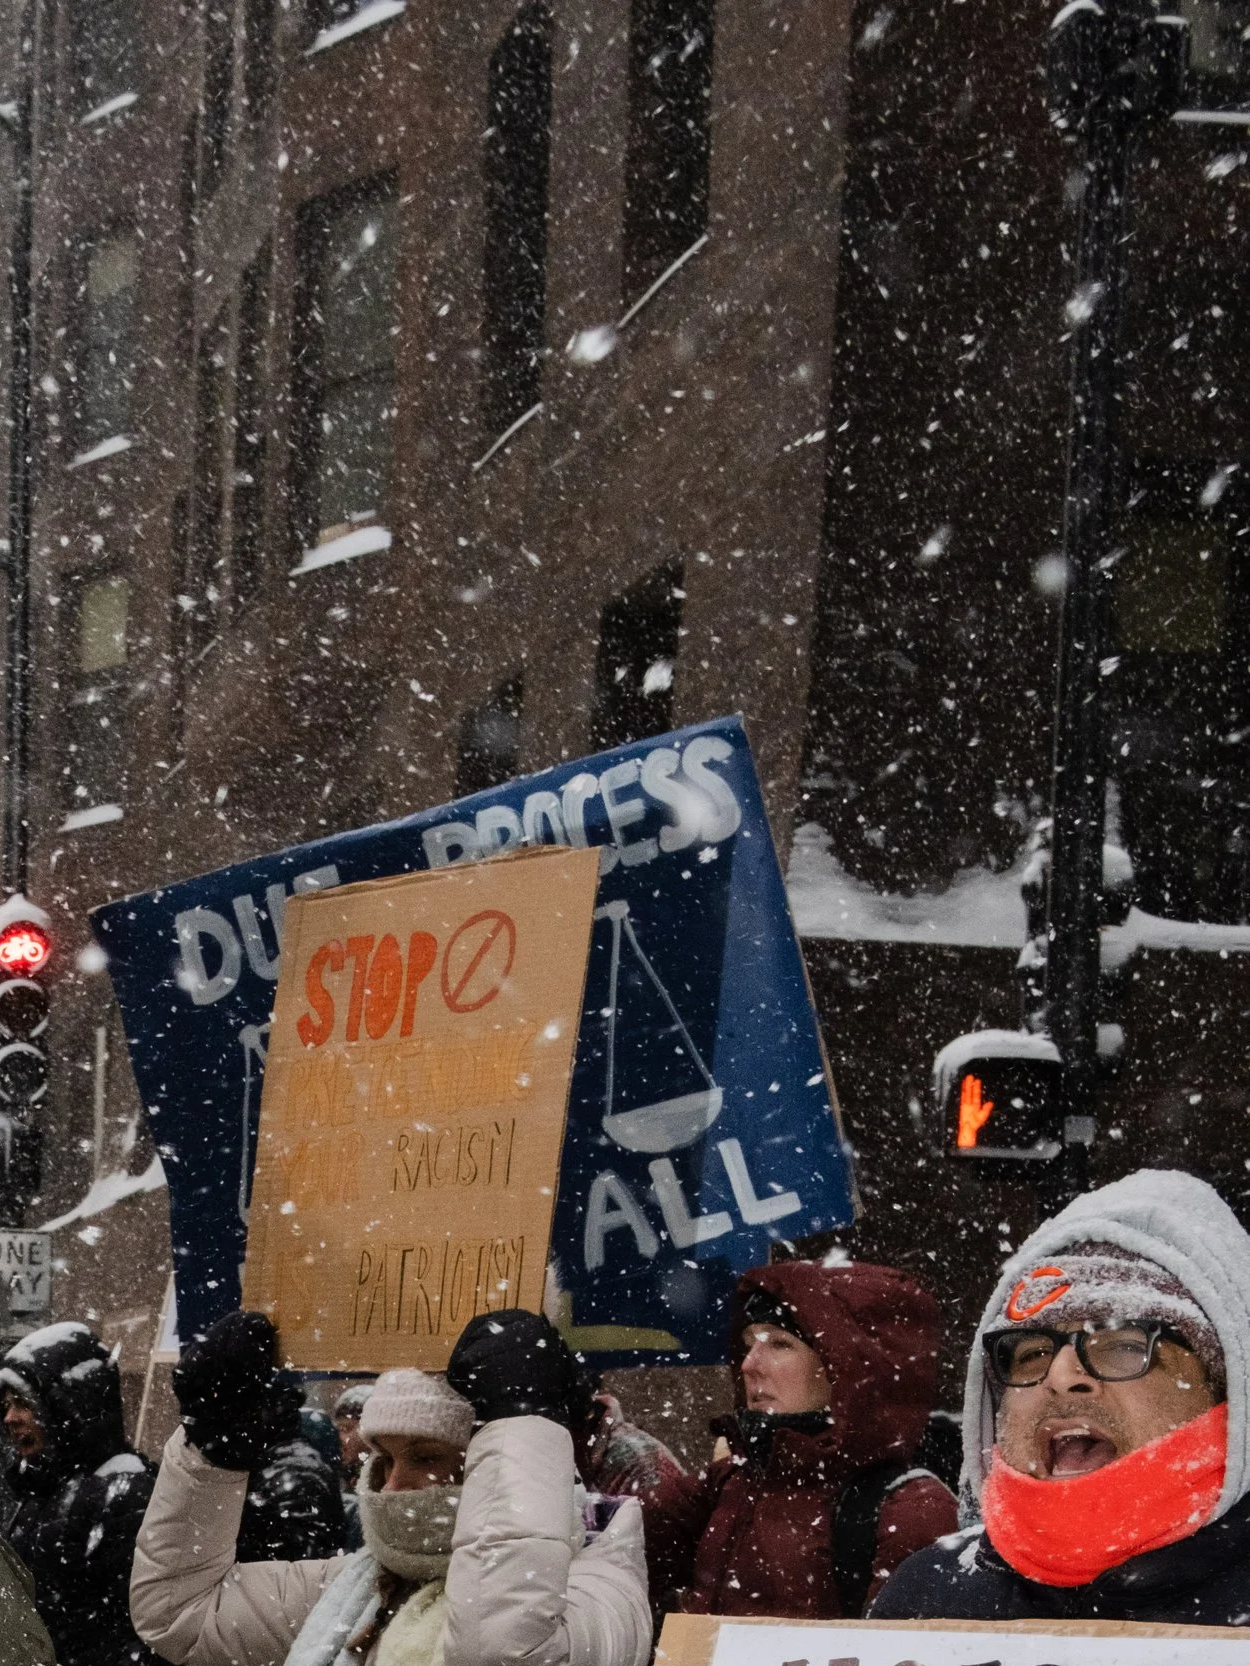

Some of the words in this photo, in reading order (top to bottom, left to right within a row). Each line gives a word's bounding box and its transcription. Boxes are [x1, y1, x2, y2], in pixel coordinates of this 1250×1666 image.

[174, 864, 340, 1005] DU
[296, 930, 438, 1048] STOP
[392, 1117, 517, 1192] RACISM
[584, 1137, 802, 1272] ALL
[350, 1235, 526, 1337] PATRIOTISM
